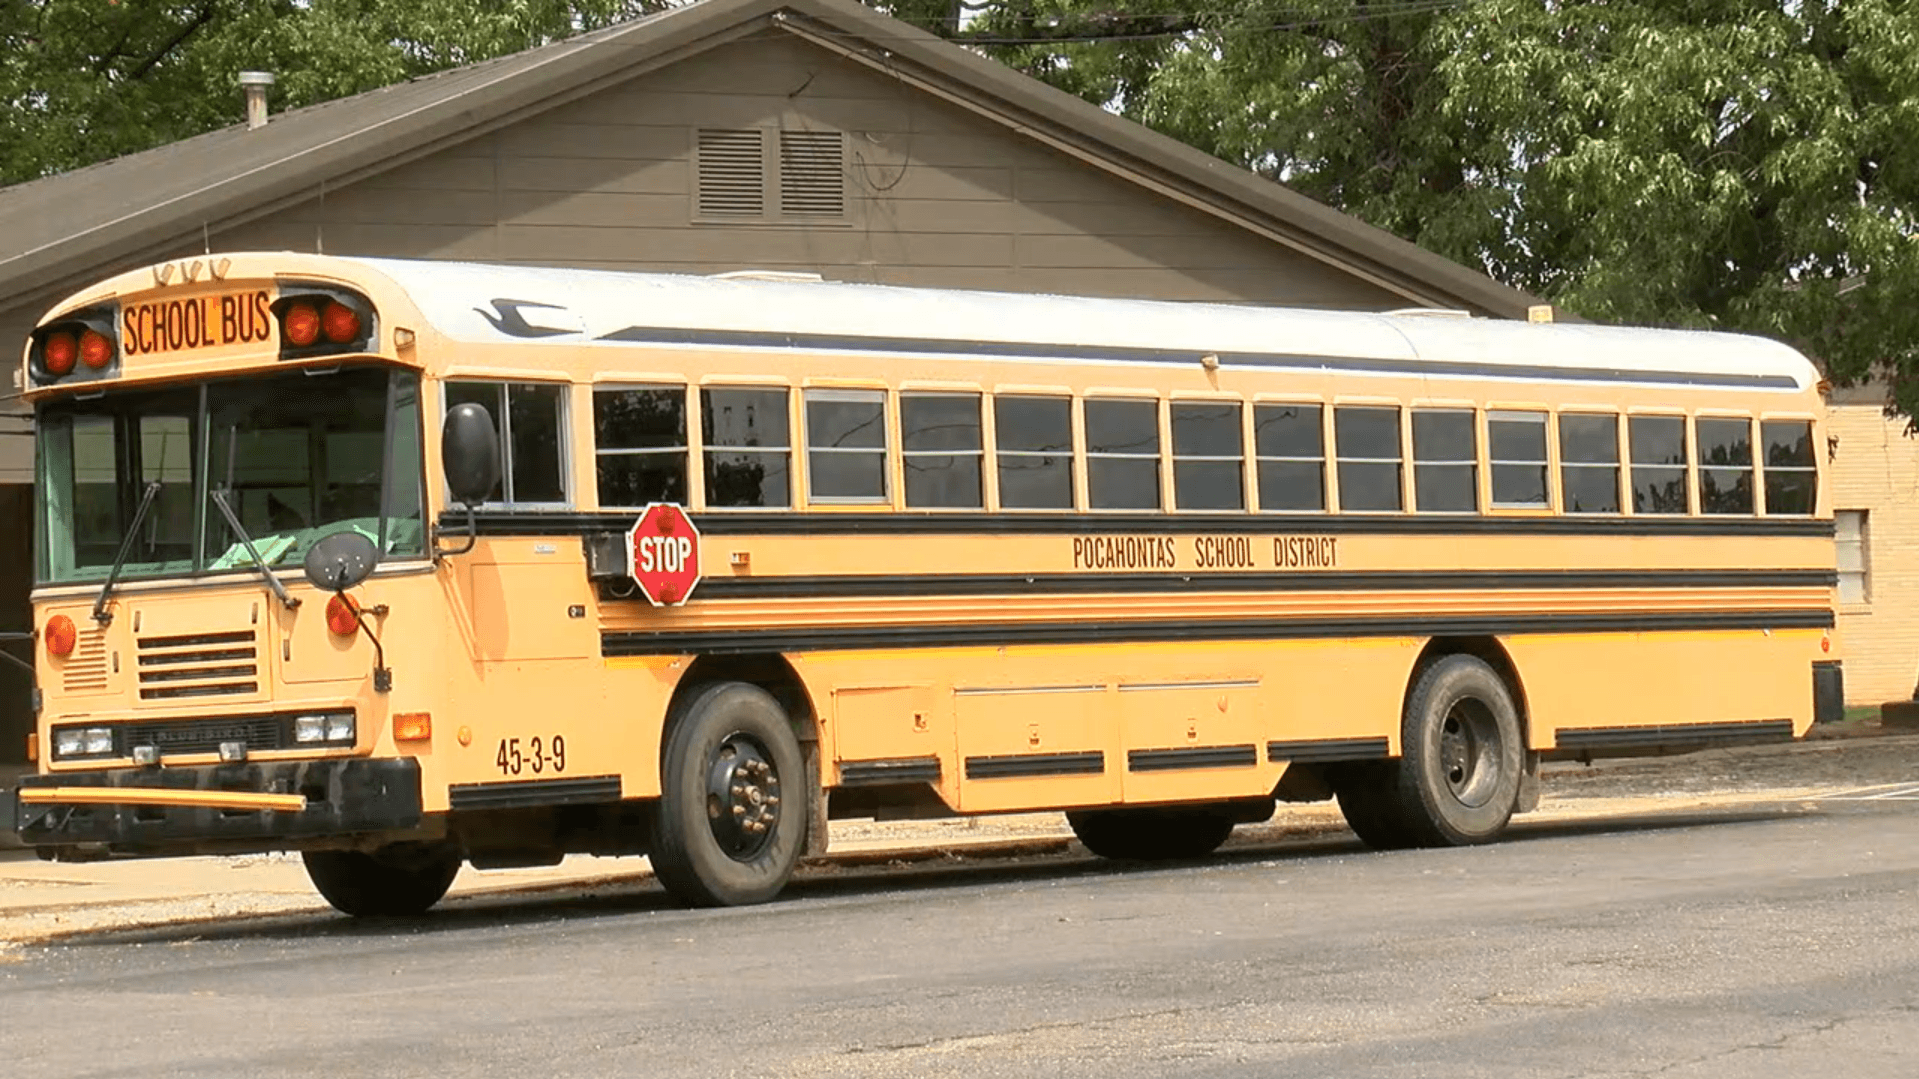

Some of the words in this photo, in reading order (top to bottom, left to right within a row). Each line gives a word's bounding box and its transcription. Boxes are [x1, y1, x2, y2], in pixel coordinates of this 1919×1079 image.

[124, 298, 215, 355] SCHOOL
[222, 291, 270, 343] BUS
[639, 536, 692, 572] STOP
[1073, 537, 1176, 568] POCAHONTAS
[1195, 537, 1255, 567] SCHOOL
[1274, 537, 1337, 567] DISTRICT
[497, 734, 565, 775] 45-3-9
